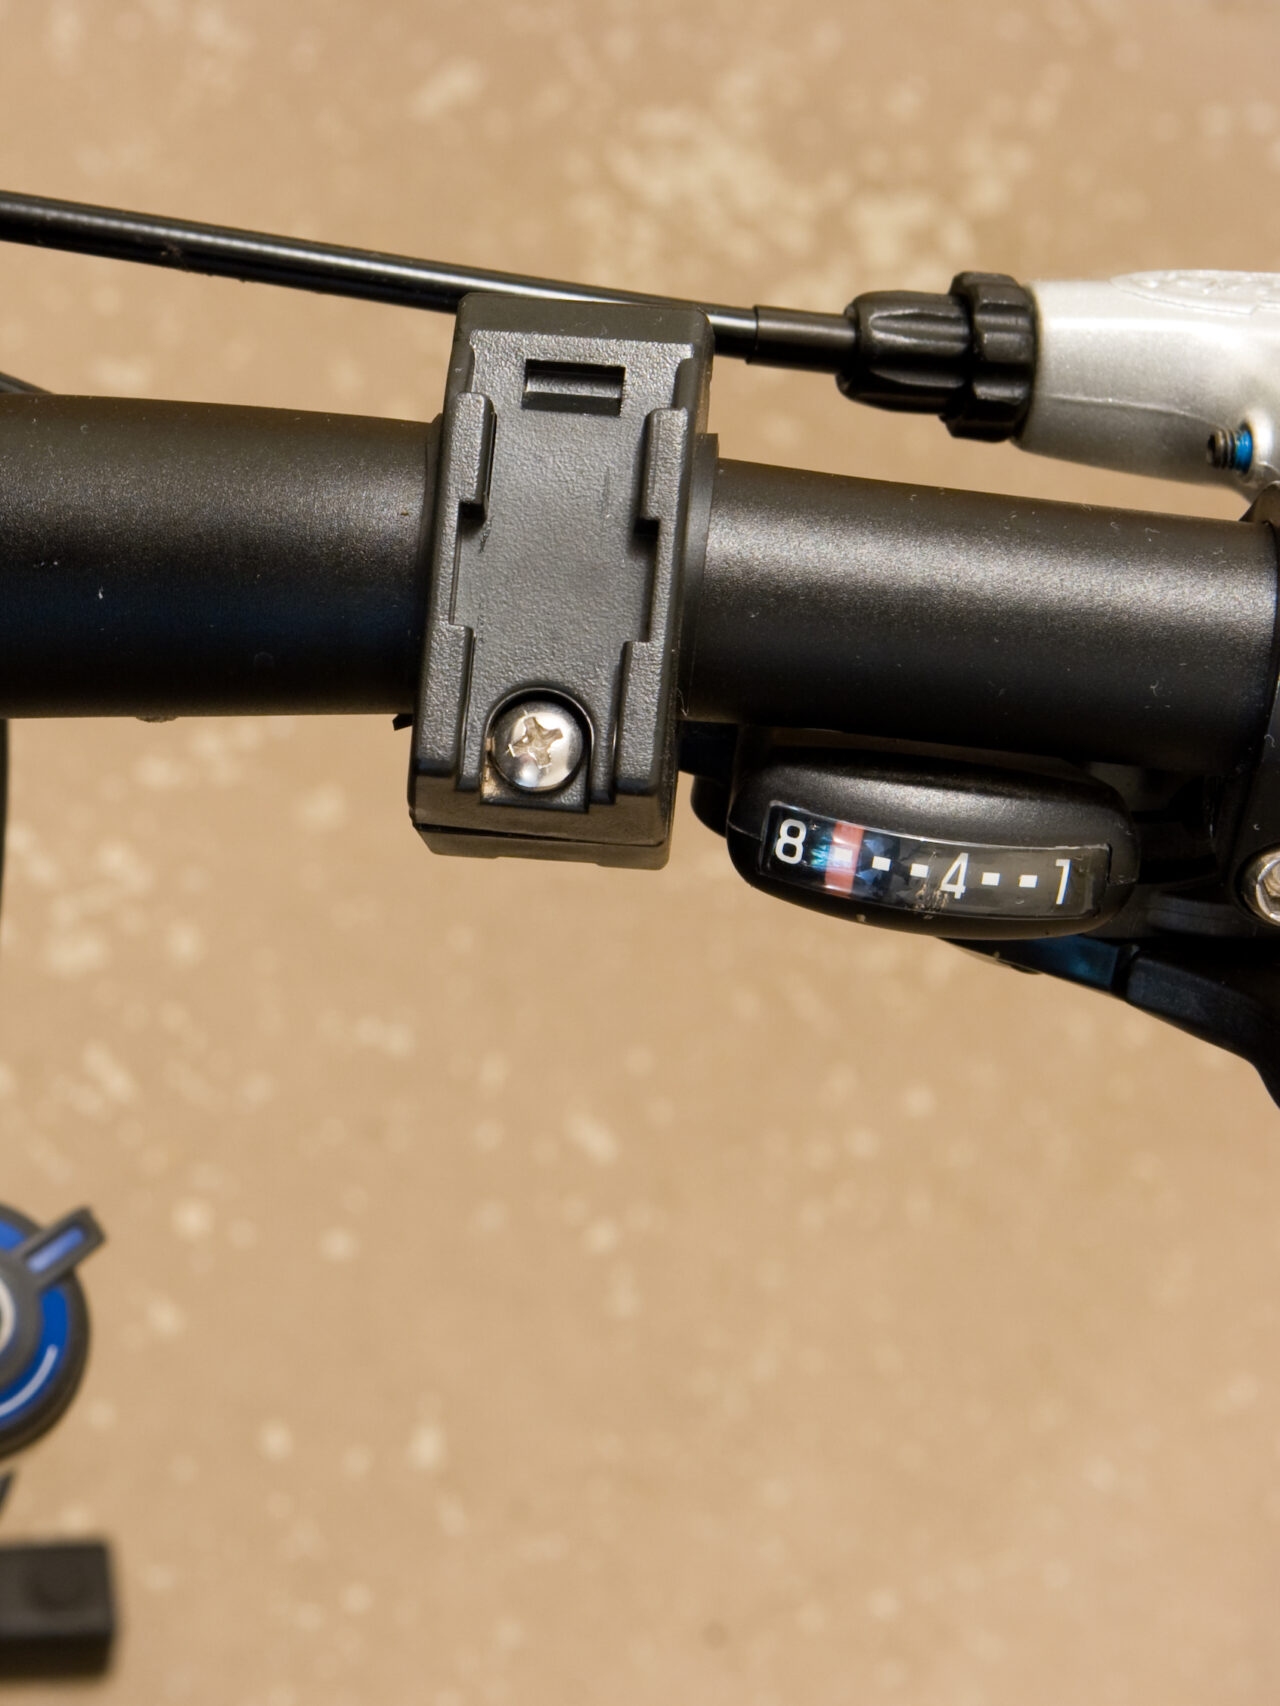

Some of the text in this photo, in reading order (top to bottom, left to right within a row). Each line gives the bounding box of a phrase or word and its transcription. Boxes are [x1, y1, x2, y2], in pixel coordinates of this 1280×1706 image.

[774, 817, 1072, 905] 8 4 1
